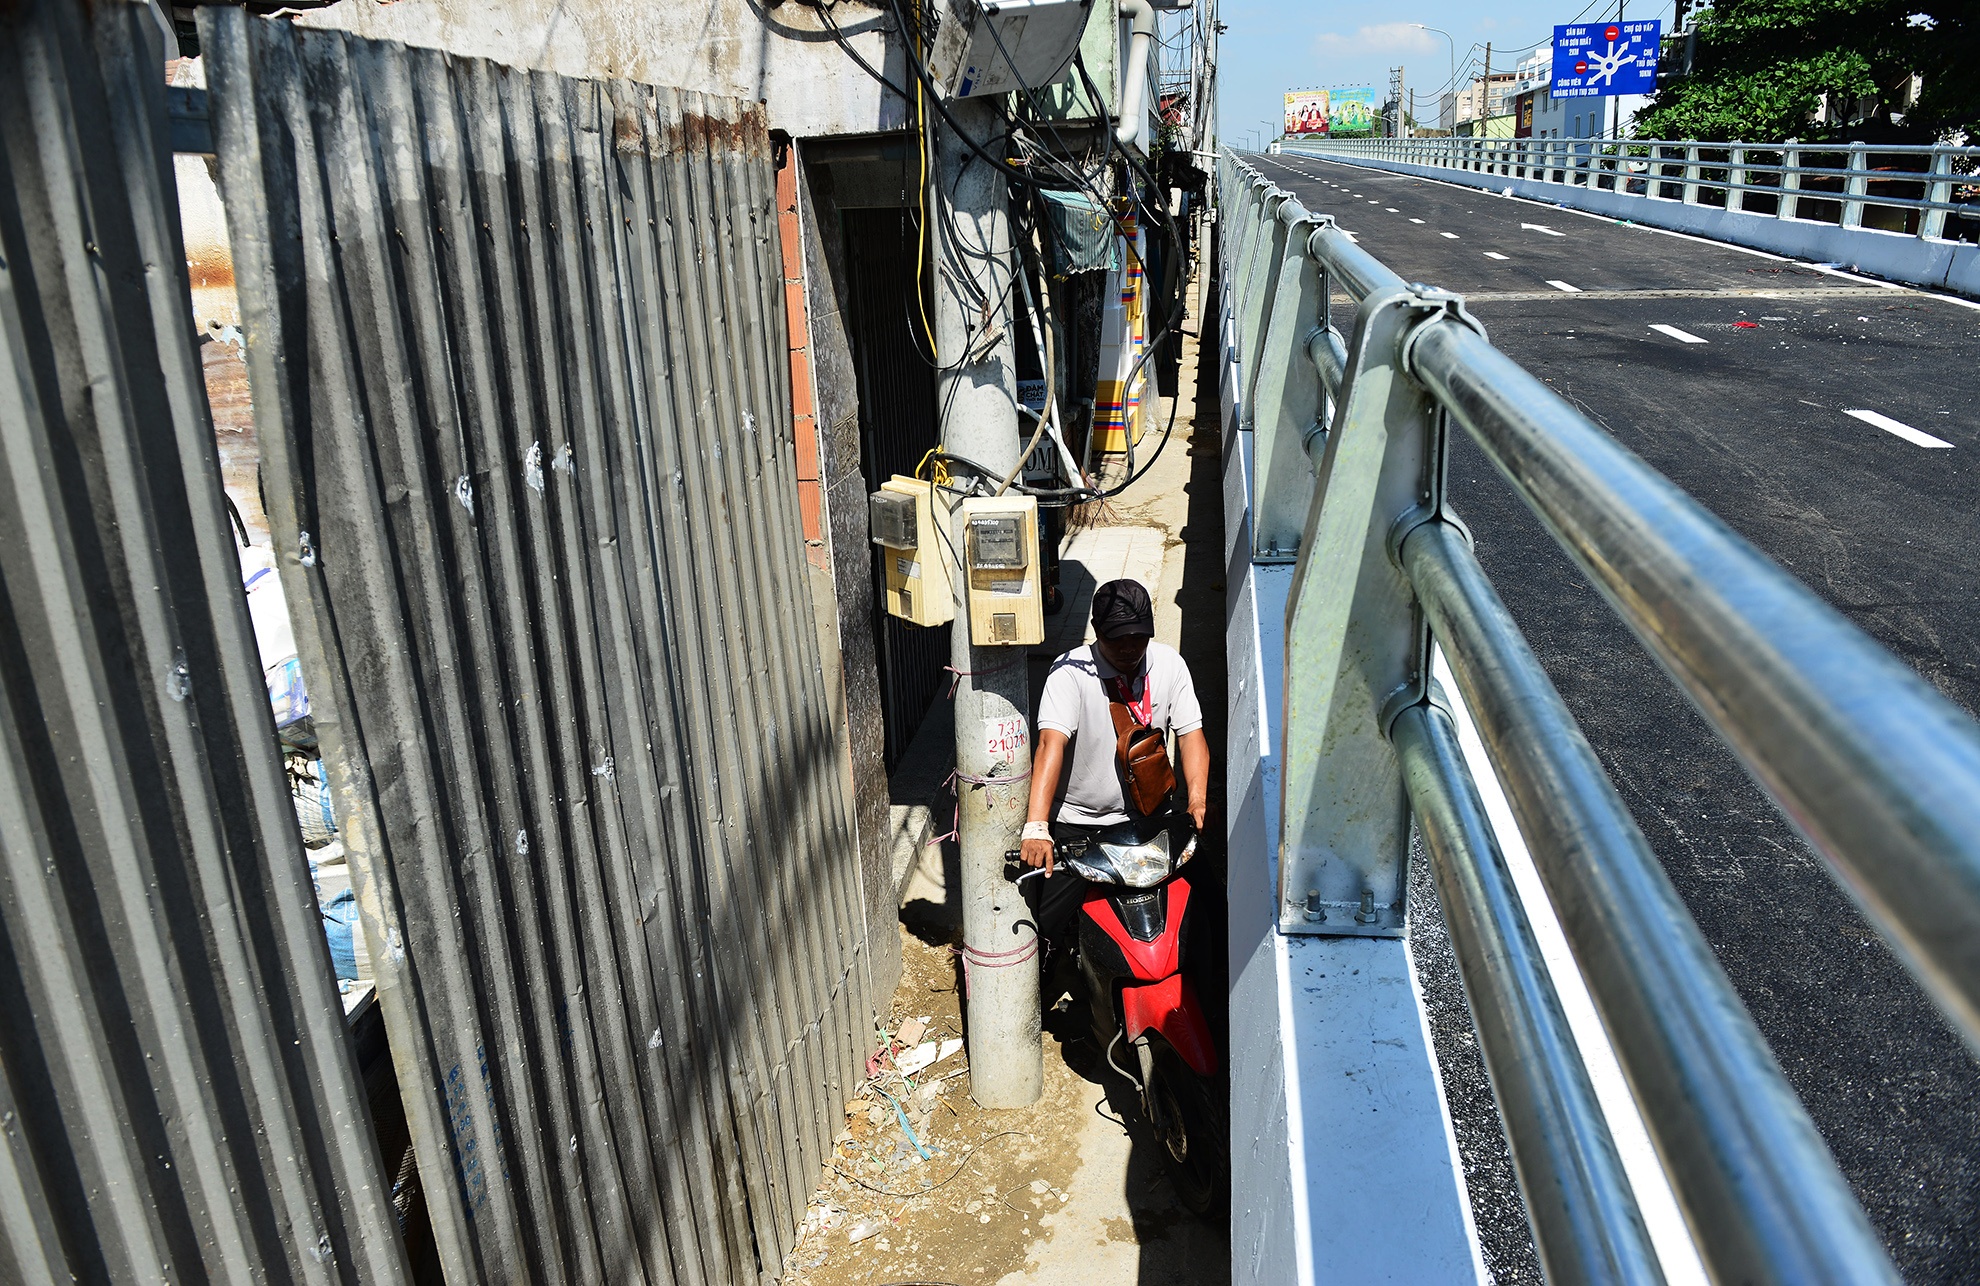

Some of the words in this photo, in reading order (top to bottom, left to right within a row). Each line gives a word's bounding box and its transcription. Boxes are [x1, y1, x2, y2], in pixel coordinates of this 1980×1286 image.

[1566, 27, 1576, 36] SÂN
[1576, 27, 1586, 35] BAY
[1635, 23, 1642, 32] GÒ
[1643, 22, 1654, 32] VẤP
[1559, 38, 1569, 47] TÂN
[1568, 48, 1579, 56] 2KM
[1639, 70, 1652, 78] 10KM
[1557, 78, 1570, 87] CÔNG
[1570, 77, 1582, 86] VIÊN
[1588, 88, 1599, 96] 2KM
[1126, 893, 1155, 904] HONDA
